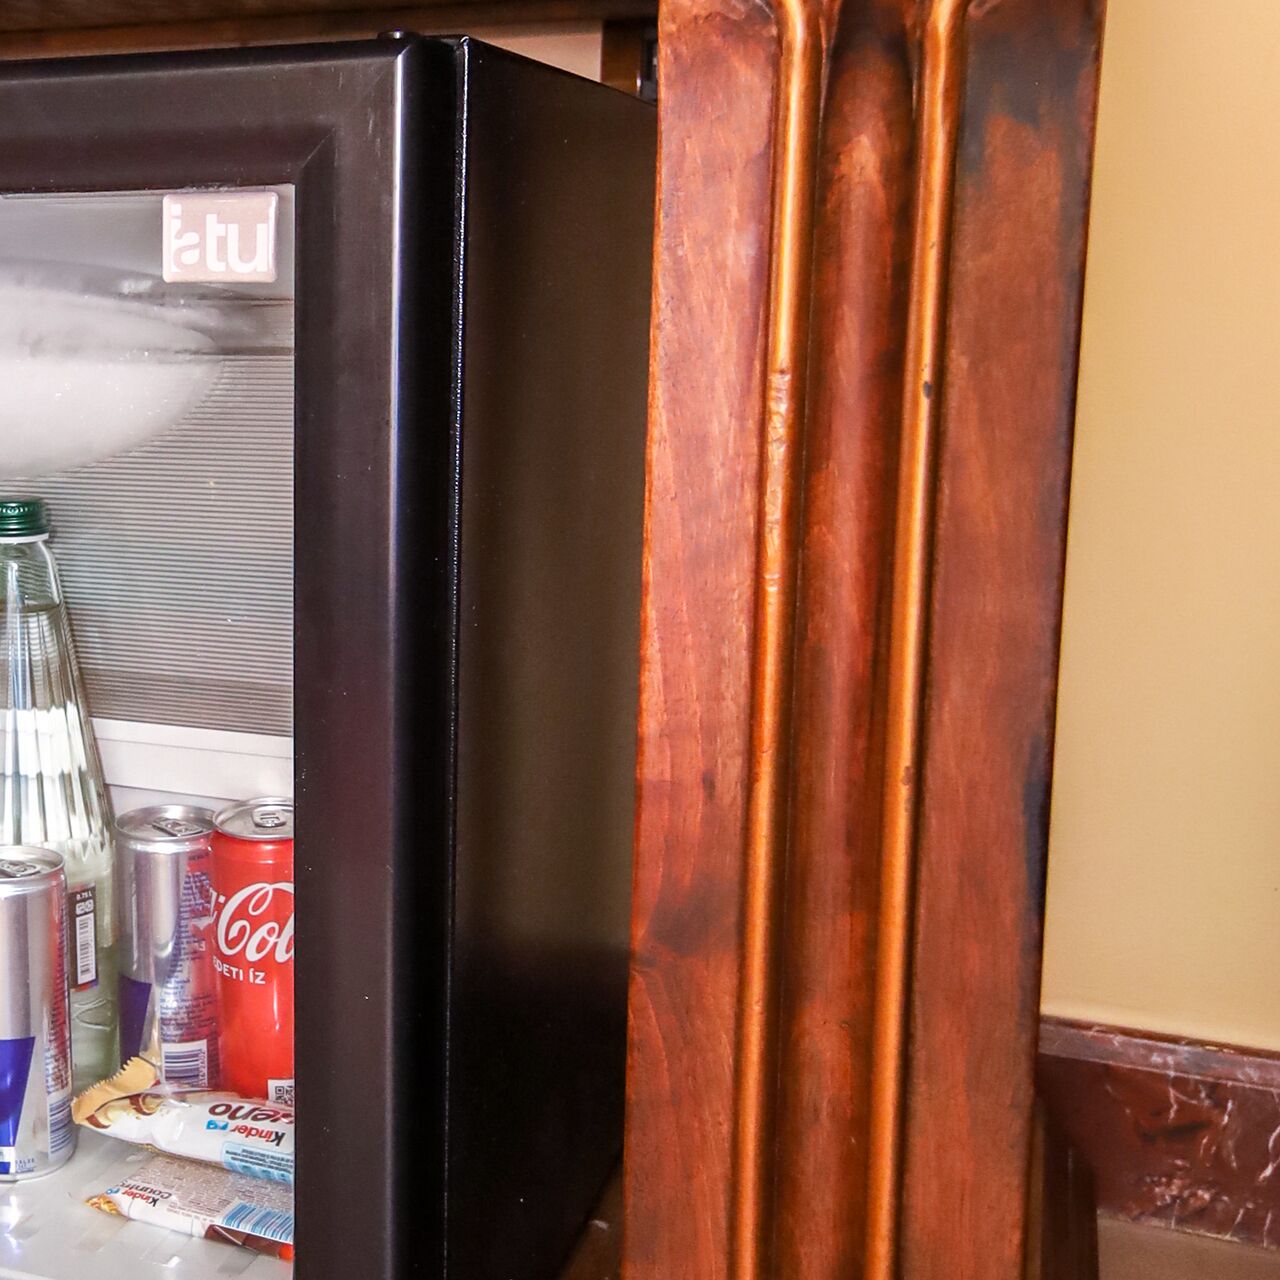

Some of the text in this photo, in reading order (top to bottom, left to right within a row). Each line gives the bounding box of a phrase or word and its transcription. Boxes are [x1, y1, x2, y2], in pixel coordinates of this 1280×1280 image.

[248, 968, 266, 984] ÍZ
[230, 1124, 286, 1147] Kinder
[122, 1188, 160, 1208] Kinder
